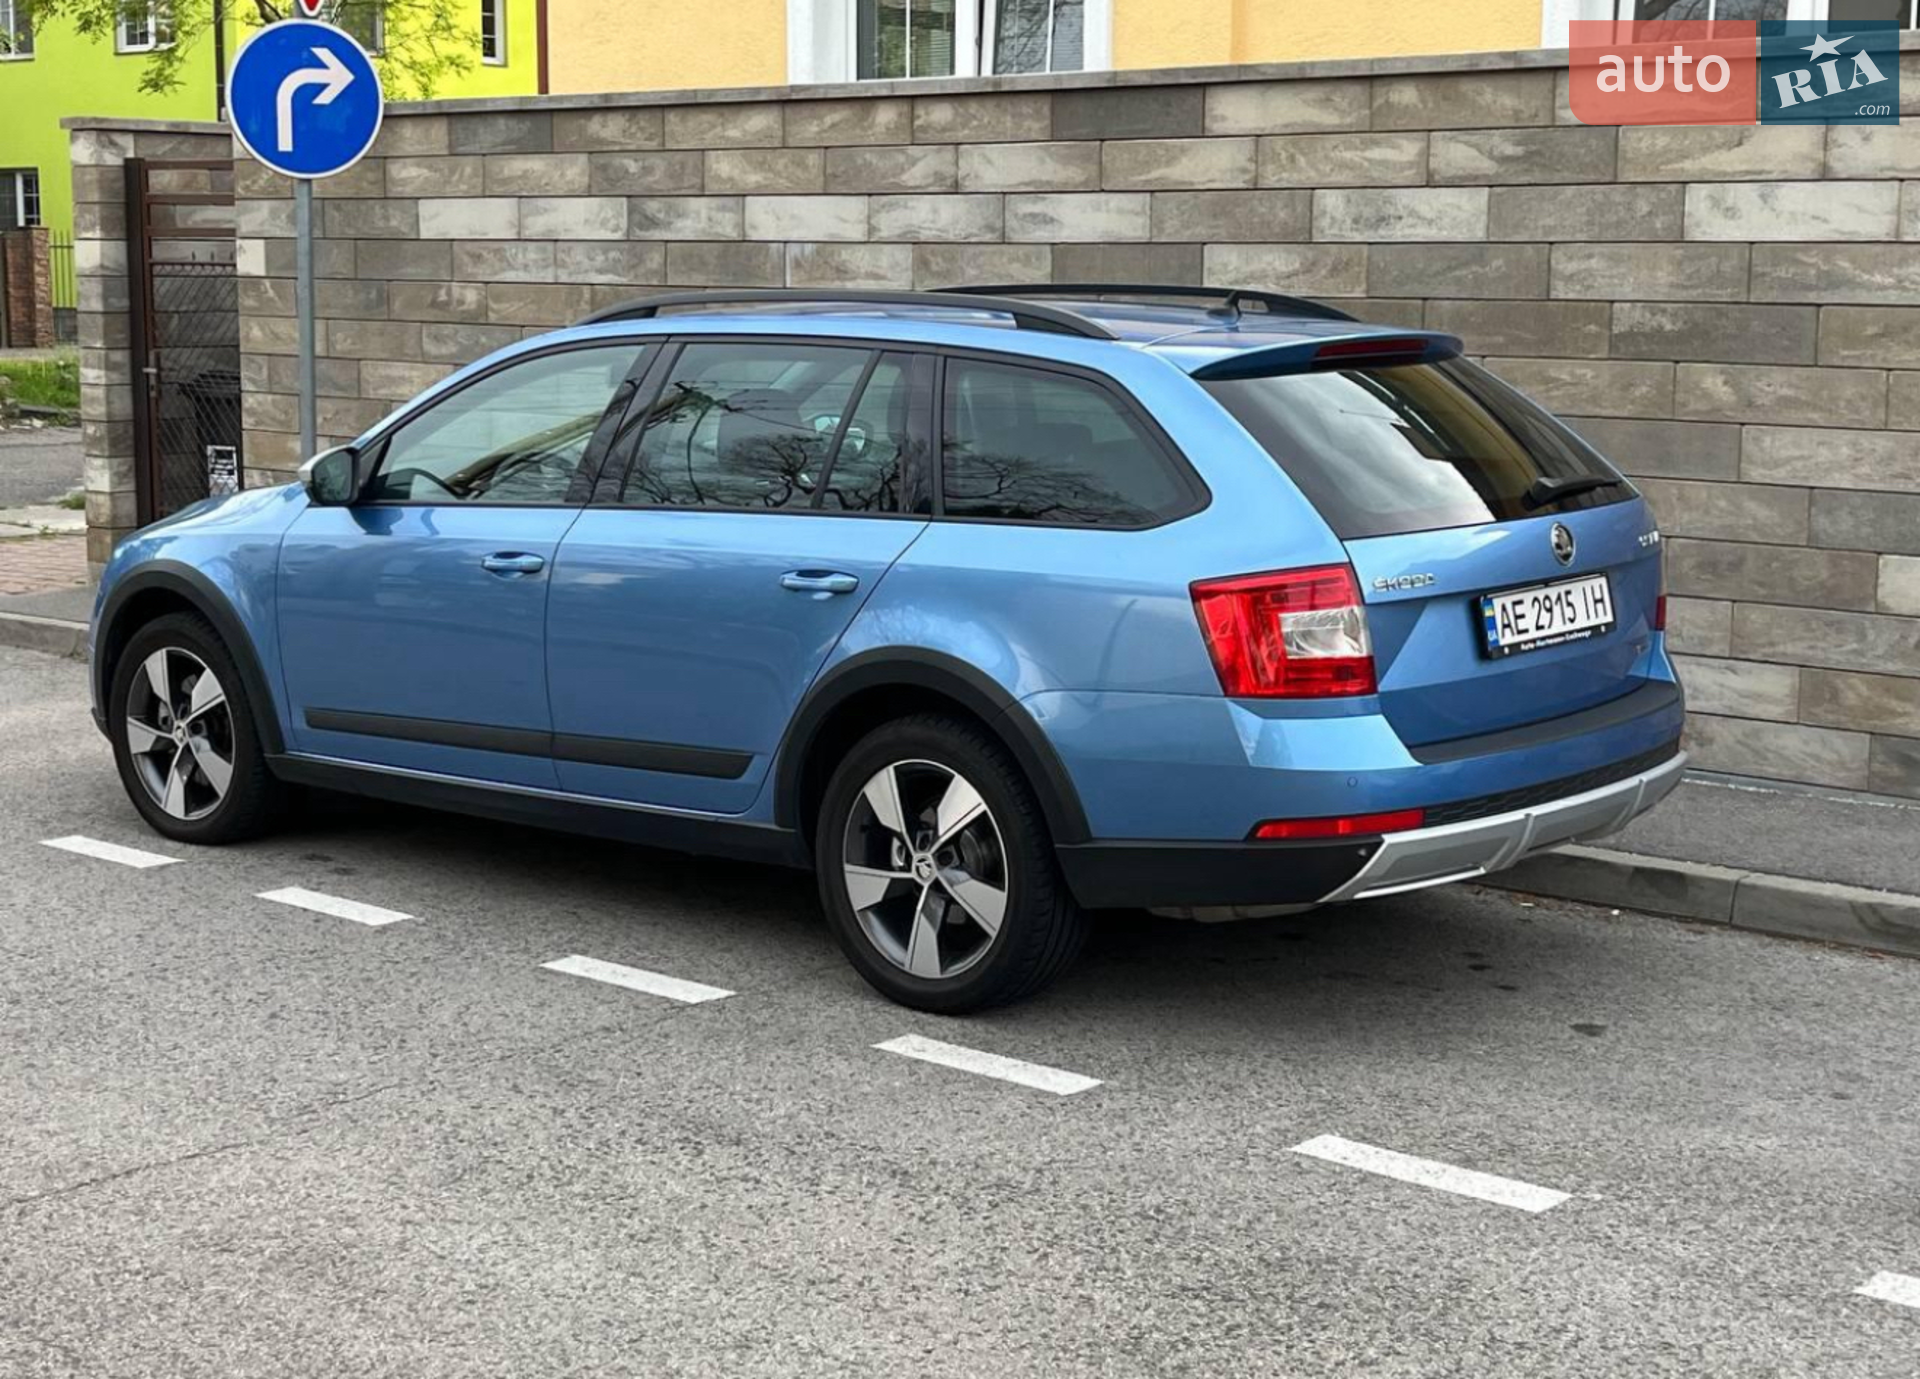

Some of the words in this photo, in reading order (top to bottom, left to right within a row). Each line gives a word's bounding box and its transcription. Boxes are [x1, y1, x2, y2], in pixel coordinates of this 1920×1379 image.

[1500, 598, 1530, 639] AE
[1531, 589, 1577, 632] 2915
[1582, 582, 1608, 621] IH
